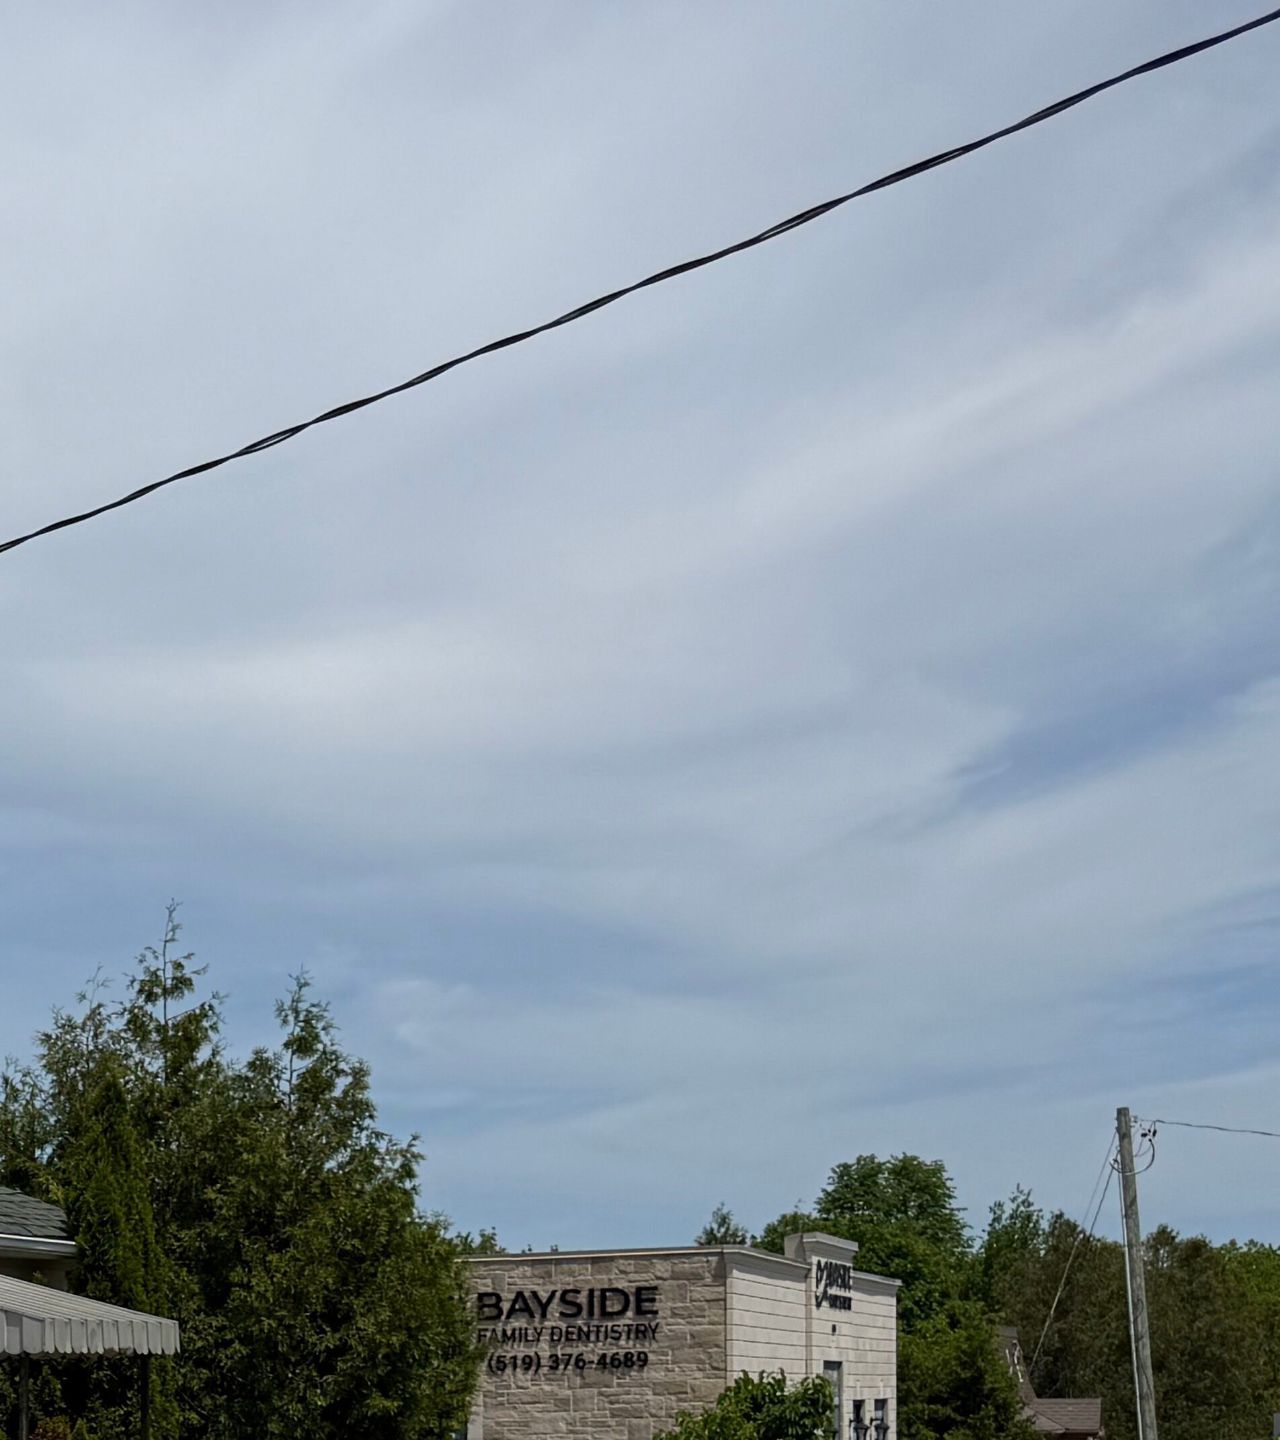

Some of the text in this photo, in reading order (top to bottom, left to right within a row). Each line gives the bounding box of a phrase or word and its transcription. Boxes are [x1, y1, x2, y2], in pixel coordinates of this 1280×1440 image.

[477, 1285, 659, 1322] BAYSIDE
[477, 1322, 660, 1343] FAMILY DENTISTRY
[488, 1350, 649, 1375] (519) 376-4689
